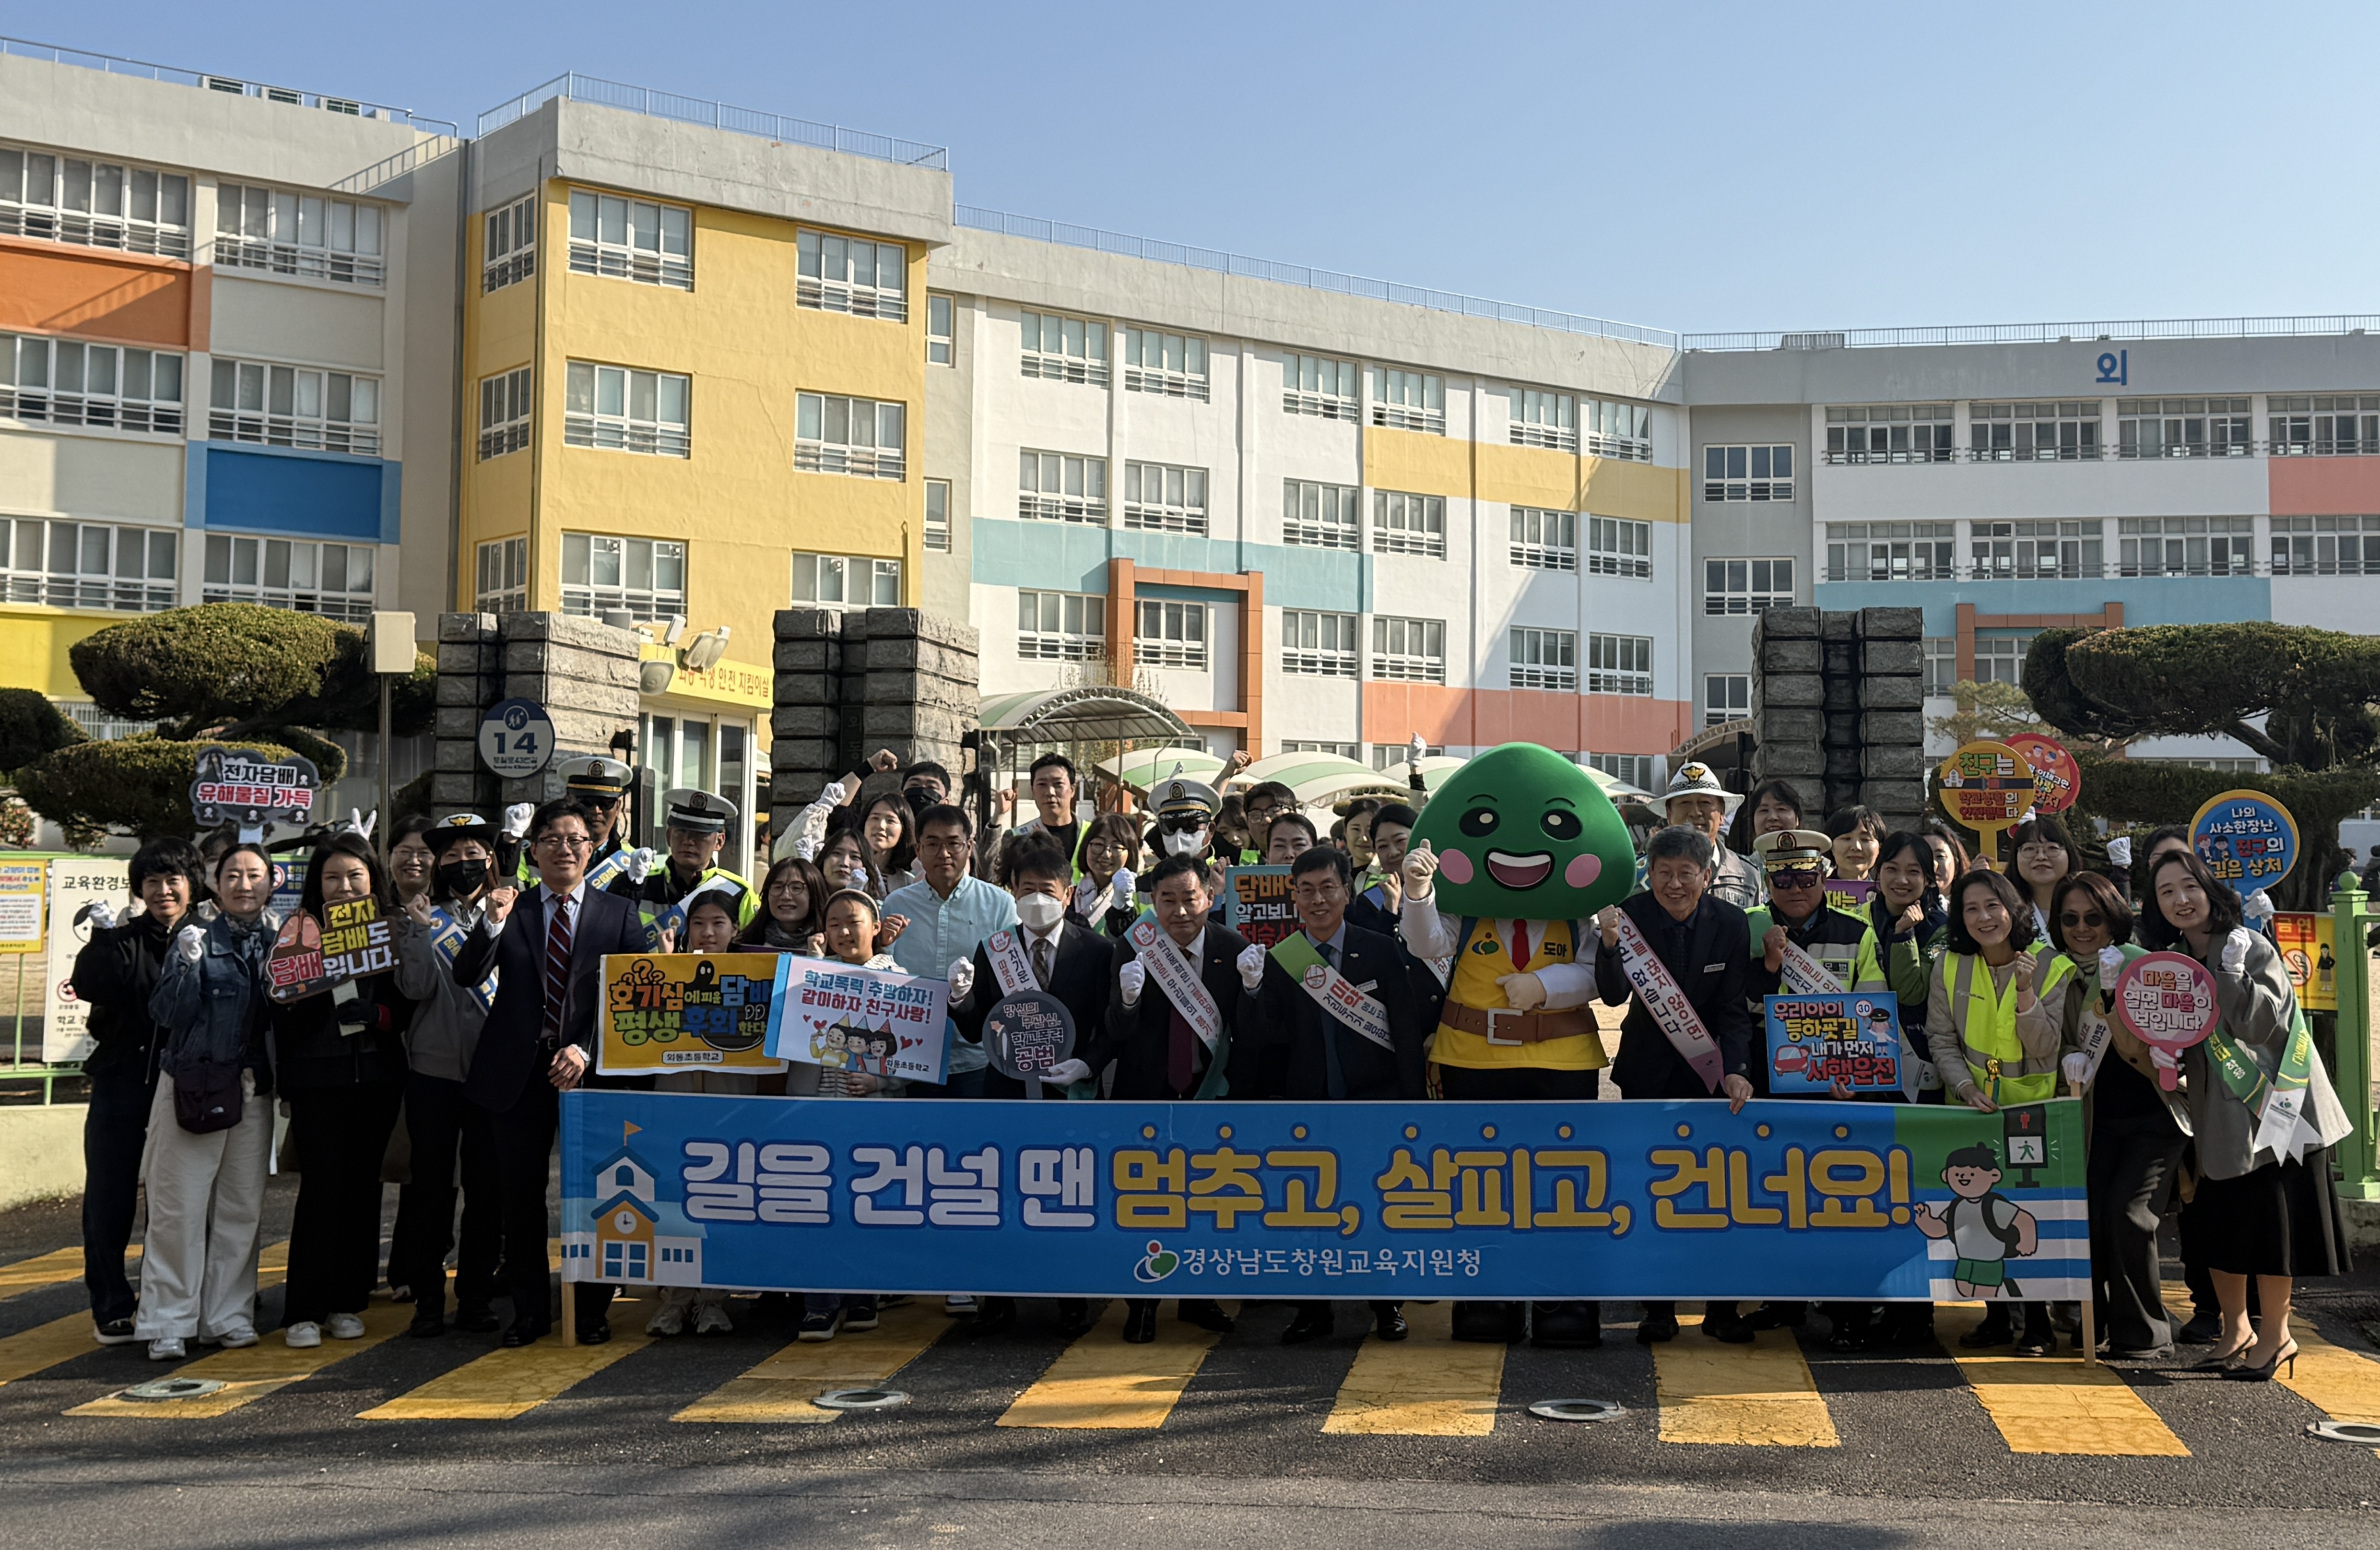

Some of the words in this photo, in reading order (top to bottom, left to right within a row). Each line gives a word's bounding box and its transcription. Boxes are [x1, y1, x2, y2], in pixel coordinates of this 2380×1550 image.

[2096, 349, 2127, 386] 외
[719, 668, 735, 692] 안전
[739, 672, 769, 698] 지킴이실
[494, 732, 538, 754] 14
[224, 764, 295, 785] 전자담배
[1959, 752, 2014, 776] 친구는
[198, 784, 271, 805] 유해물질
[274, 788, 312, 809] 가득
[1959, 792, 2019, 805] 학교생활의
[2231, 806, 2256, 818] 나의
[2236, 837, 2285, 857] 친구의
[2210, 859, 2243, 879] 깊은
[2248, 857, 2282, 877] 상처
[328, 898, 376, 928] 전자
[321, 921, 391, 956] 담배도
[1236, 922, 1306, 948] 저승사
[1543, 941, 1567, 958] 도아
[1008, 947, 1029, 983] 차가운
[804, 970, 864, 994] 학교폭력
[868, 980, 934, 1006] 추방하자!
[1621, 924, 1648, 957] 오늘
[1667, 992, 1705, 1041] 않으면
[2143, 970, 2191, 992] 마음을
[801, 988, 862, 1013] 같이하자
[866, 998, 931, 1024] 친구사랑!
[1631, 968, 1682, 1034] 없습니다
[1857, 1004, 1870, 1013] 30
[2123, 990, 2158, 1010] 열면
[2161, 992, 2213, 1011] 마음이
[1785, 1018, 1857, 1042] 등하굣길
[2134, 1011, 2203, 1031] 보입니다
[1011, 1028, 1063, 1048] 학교폭력
[666, 1053, 719, 1062] 외동초등학교
[886, 1058, 930, 1072] 외동초등학교
[1015, 1044, 1055, 1072] 공범
[1806, 1057, 1896, 1085] 서행운전
[683, 1142, 832, 1225] 길을
[850, 1146, 1001, 1227] 건널
[1018, 1147, 1096, 1228] 땐
[1112, 1147, 1360, 1236] 멈추고,
[1377, 1148, 1632, 1236] 살피고,
[1650, 1147, 1911, 1229] 건너요!
[1182, 1248, 1481, 1278] 경상남도창원교육지원청
